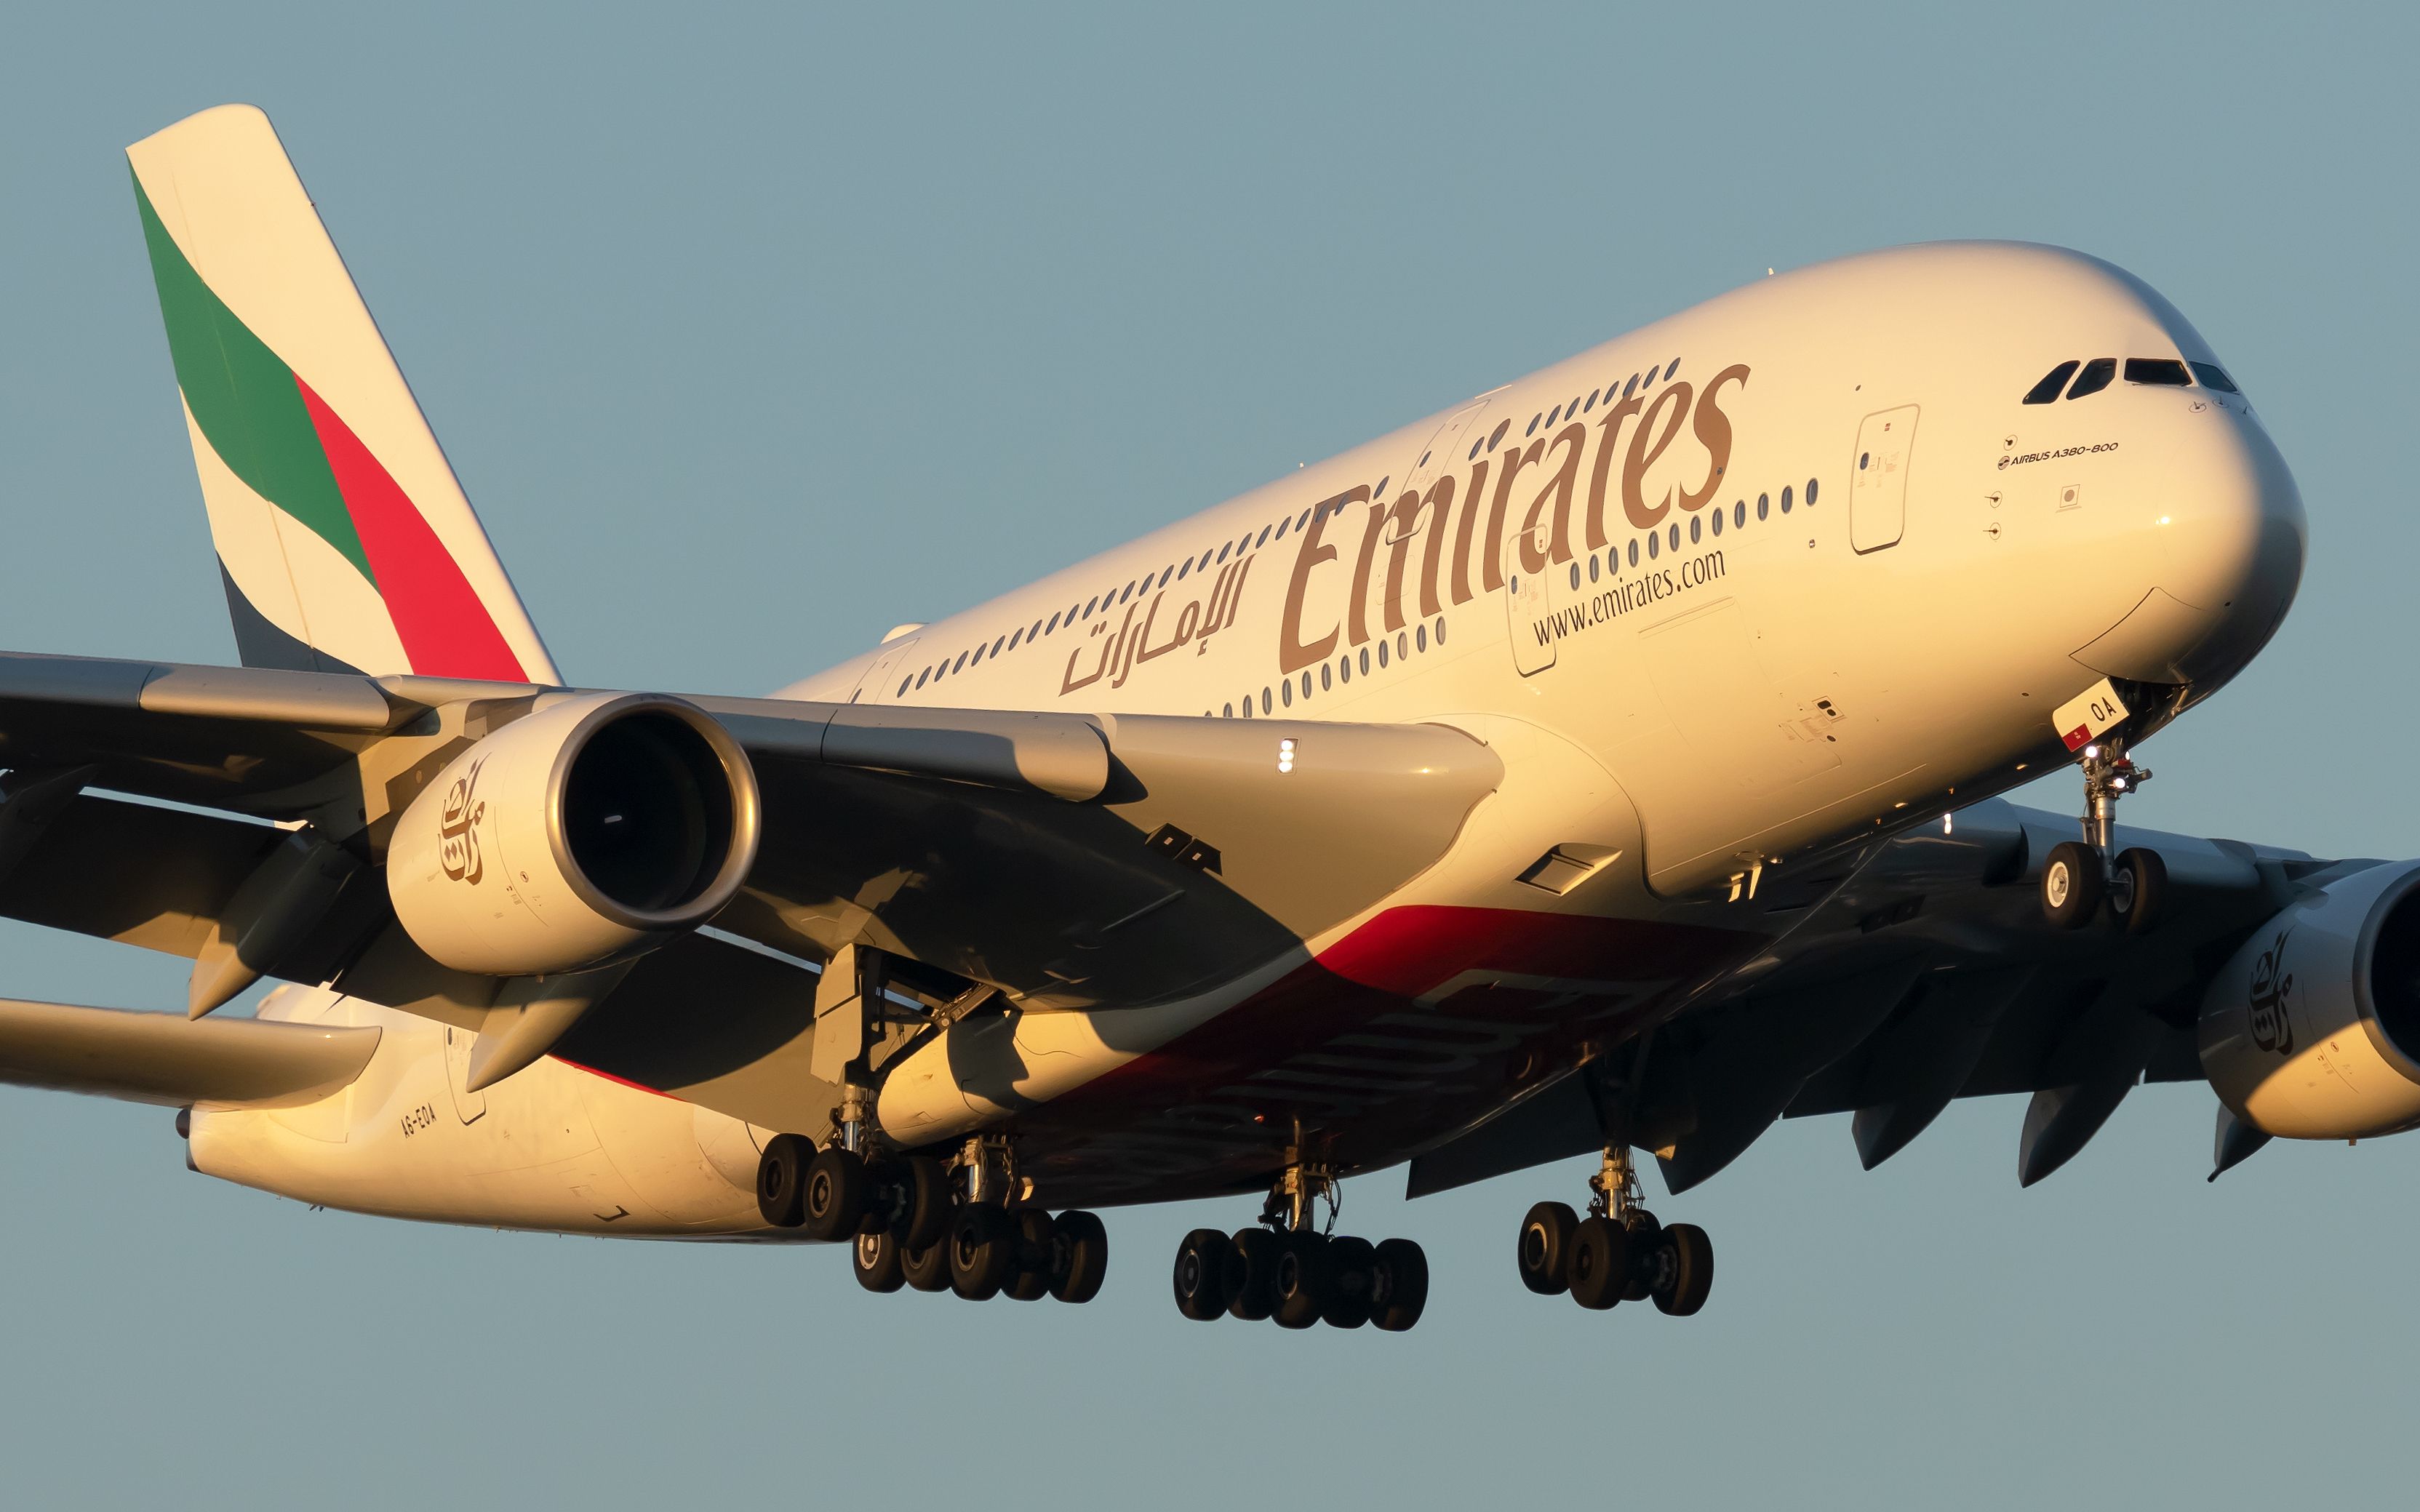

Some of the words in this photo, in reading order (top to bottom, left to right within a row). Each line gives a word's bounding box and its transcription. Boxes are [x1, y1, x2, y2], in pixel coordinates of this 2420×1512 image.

[2010, 451, 2051, 466] AIRBUS
[2051, 441, 2119, 460] A380-800
[1279, 364, 1751, 675] Emirates
[1058, 553, 1257, 697] الإمارات
[1533, 550, 1726, 647] www.emirates.com
[2090, 697, 2117, 722] OA
[401, 1102, 437, 1139] A6-EOA
